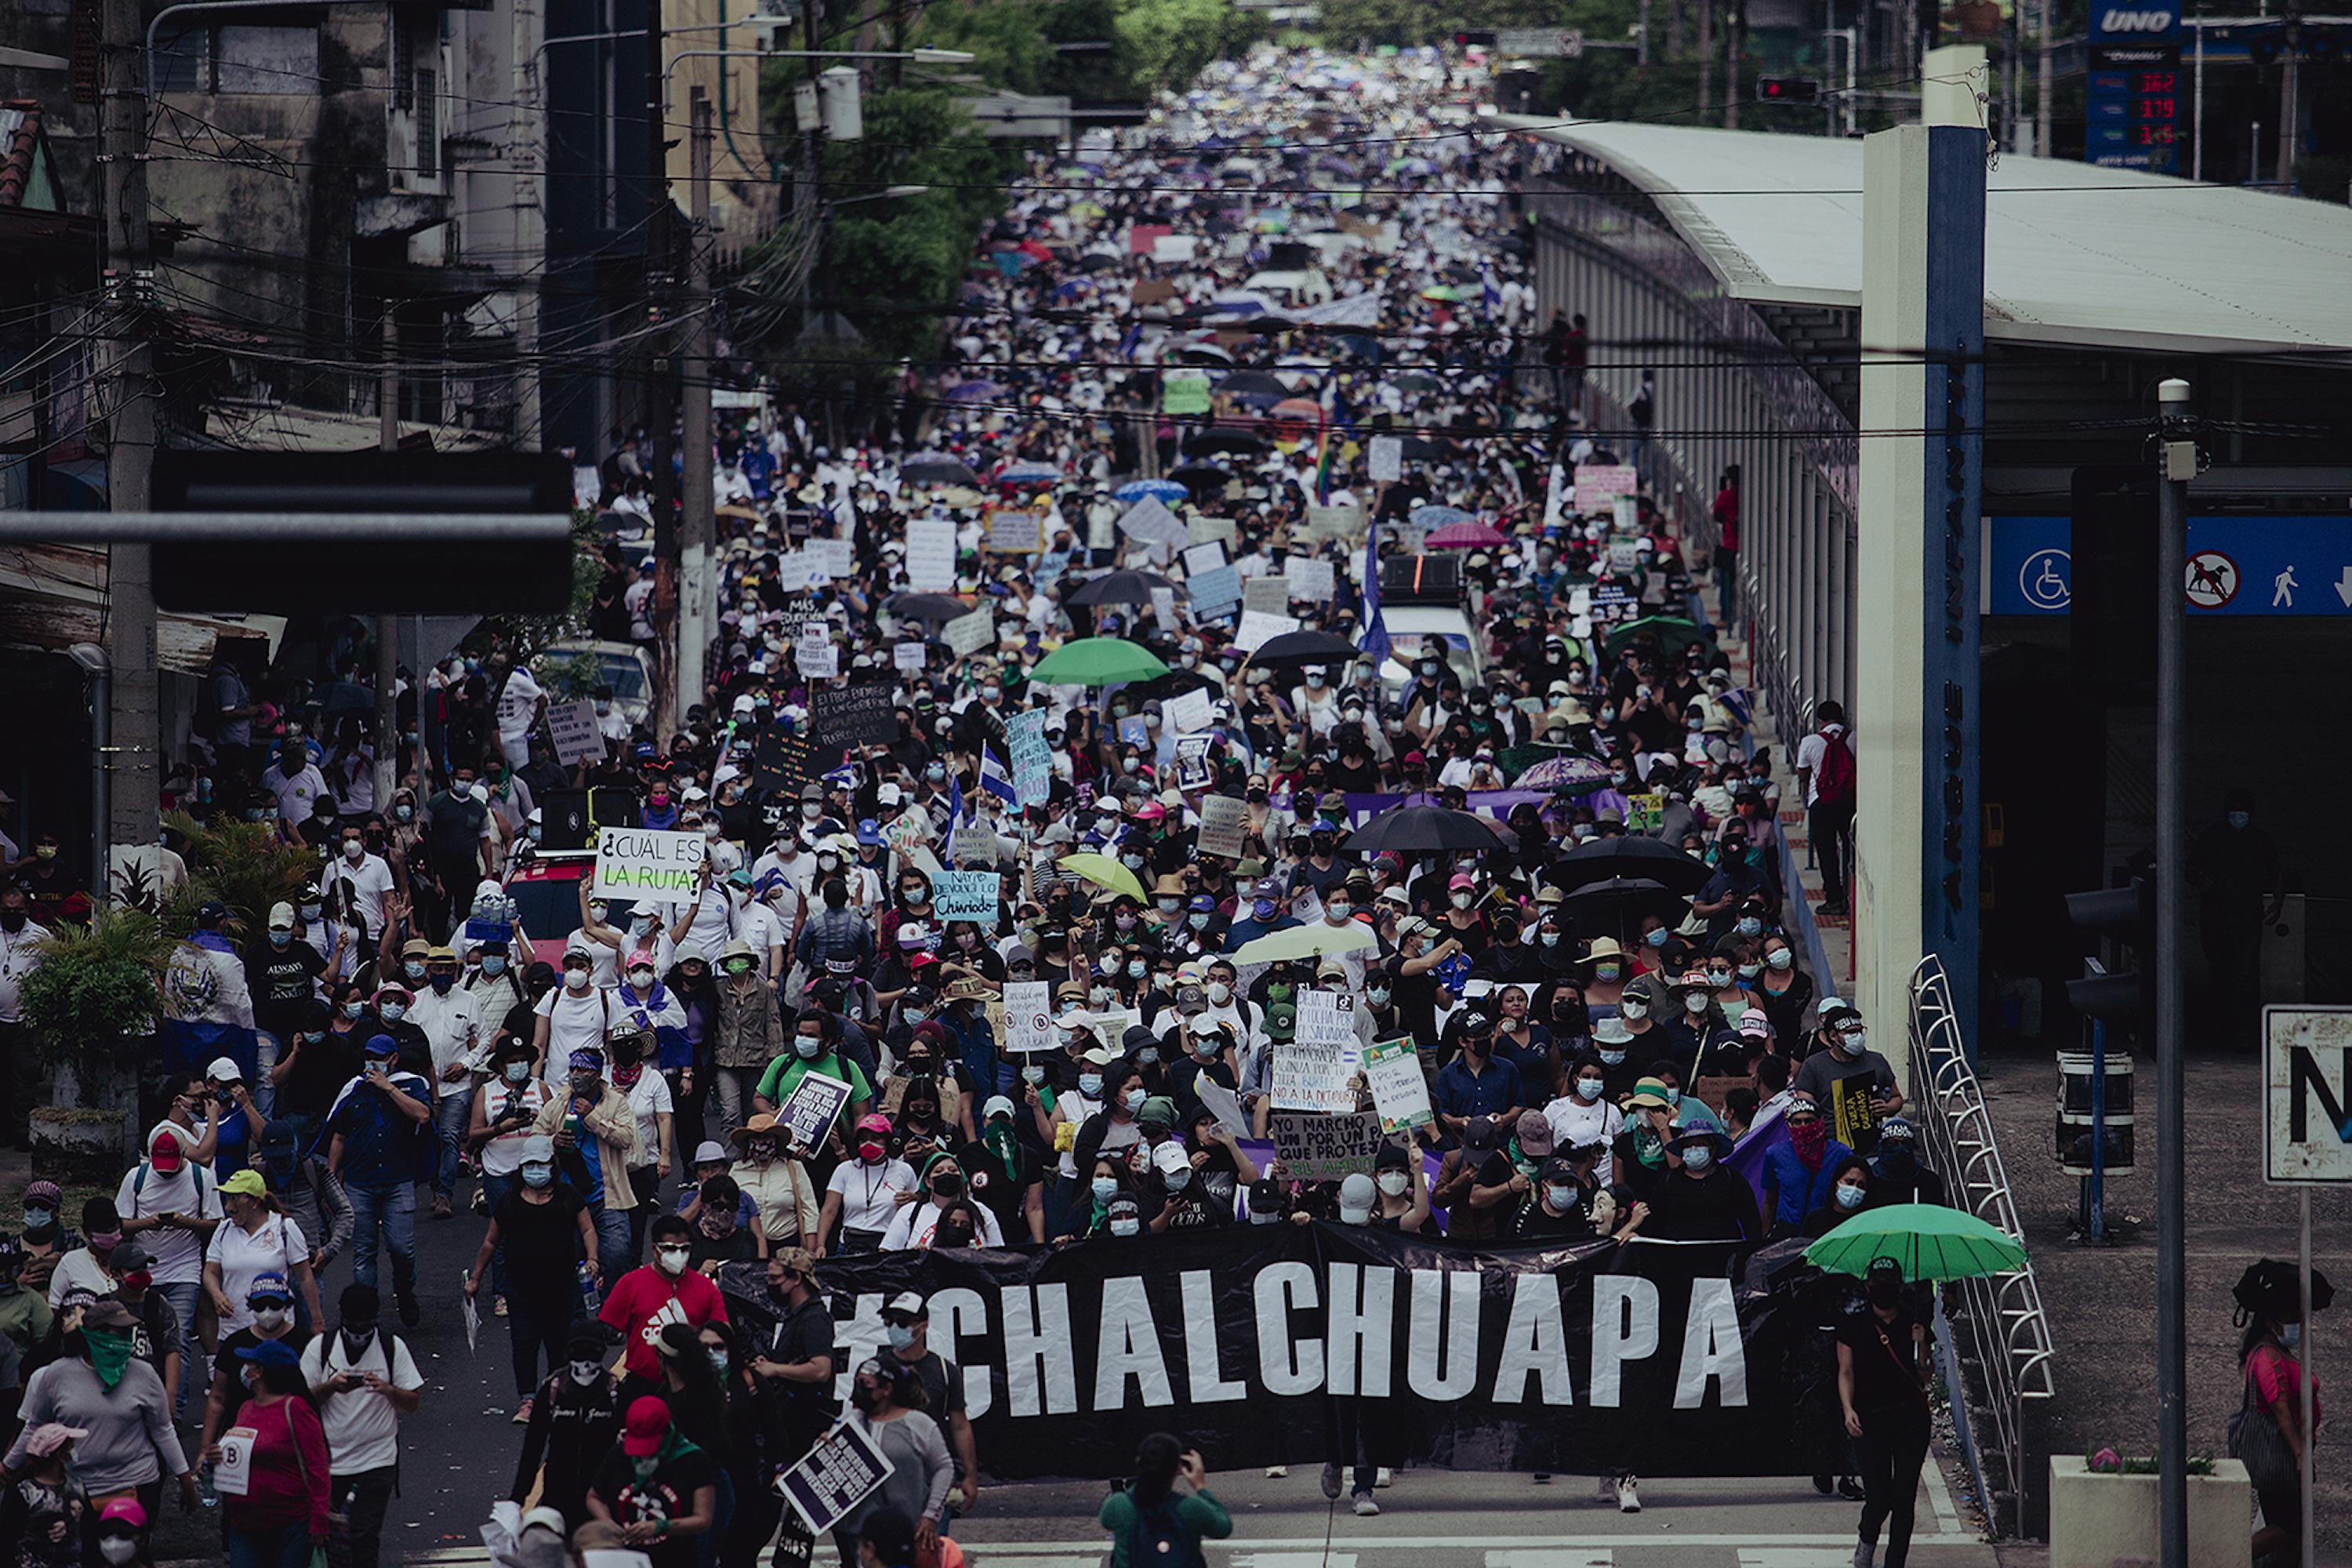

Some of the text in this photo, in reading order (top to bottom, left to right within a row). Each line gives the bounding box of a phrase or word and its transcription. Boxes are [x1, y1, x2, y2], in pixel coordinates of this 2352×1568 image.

[2100, 9, 2172, 33] UNO
[603, 833, 702, 862] ¿CUÁL ES
[604, 864, 702, 895] LA RUTA?
[952, 872, 986, 883] NAYIB
[982, 883, 996, 894] LO
[1298, 991, 1323, 1006] DEJA
[1298, 1006, 1355, 1025] Y LUCHA POR
[1308, 1025, 1351, 1041] SALVADOR
[1312, 1063, 1328, 1075] POR
[1334, 1064, 1345, 1076] TU
[1273, 1087, 1287, 1098] NO
[1290, 1087, 1298, 1098] A
[1302, 1089, 1315, 1100] LA
[1274, 1116, 1365, 1132] YO MARCHO
[1276, 1134, 1300, 1146] UN
[1307, 1131, 1329, 1145] POR
[1339, 1127, 1364, 1144] UN
[1279, 1145, 1311, 1161] QUE
[829, 1261, 1749, 1419] #CHALCHUAPA
[815, 1447, 848, 1486] QUEREMOS
[833, 1433, 877, 1484] NO QUEREMOS
[836, 1455, 869, 1494] SOLDADOS
[797, 1461, 844, 1519] UNIVERSITARIAS
